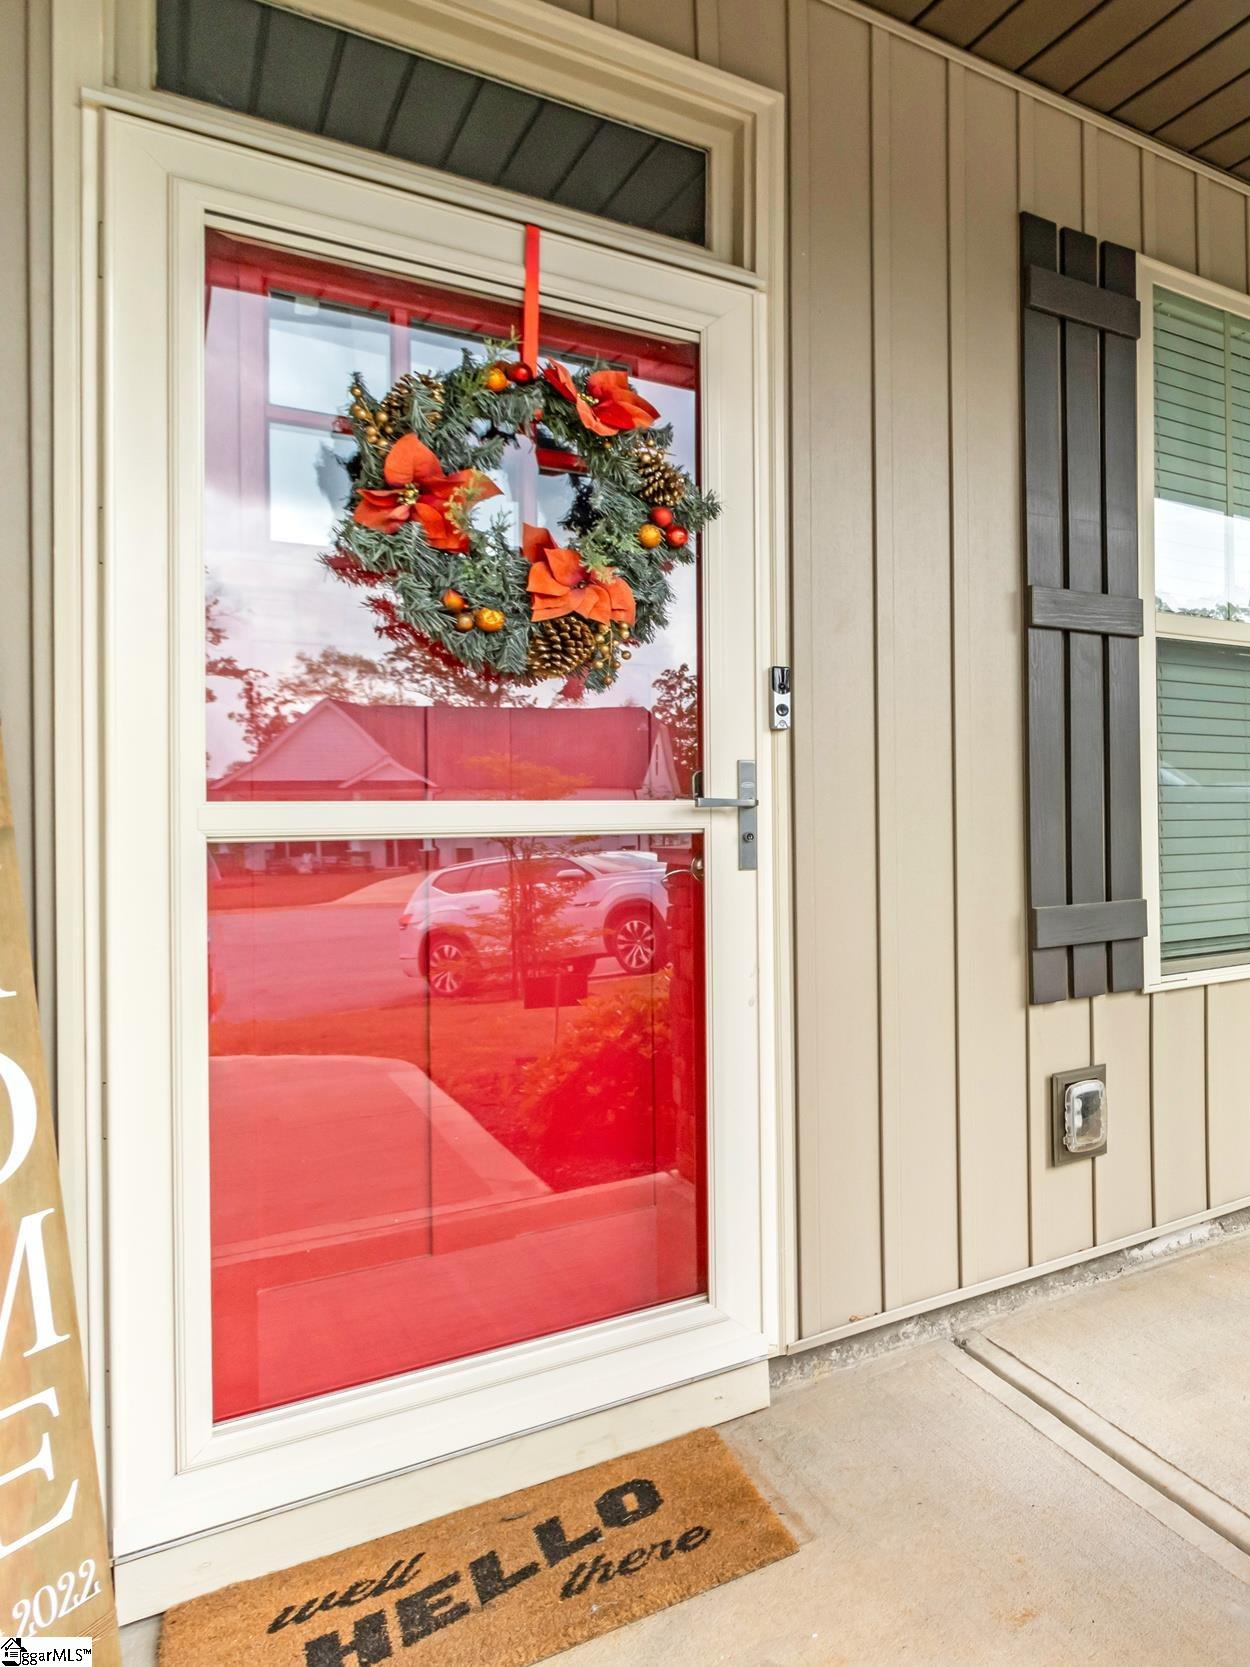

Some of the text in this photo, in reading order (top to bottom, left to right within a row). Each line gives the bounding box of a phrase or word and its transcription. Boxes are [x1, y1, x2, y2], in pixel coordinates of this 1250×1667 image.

[12, 1559, 102, 1637] 2022
[266, 1551, 427, 1634] well
[304, 1479, 664, 1667] HELLO
[559, 1525, 712, 1601] there
